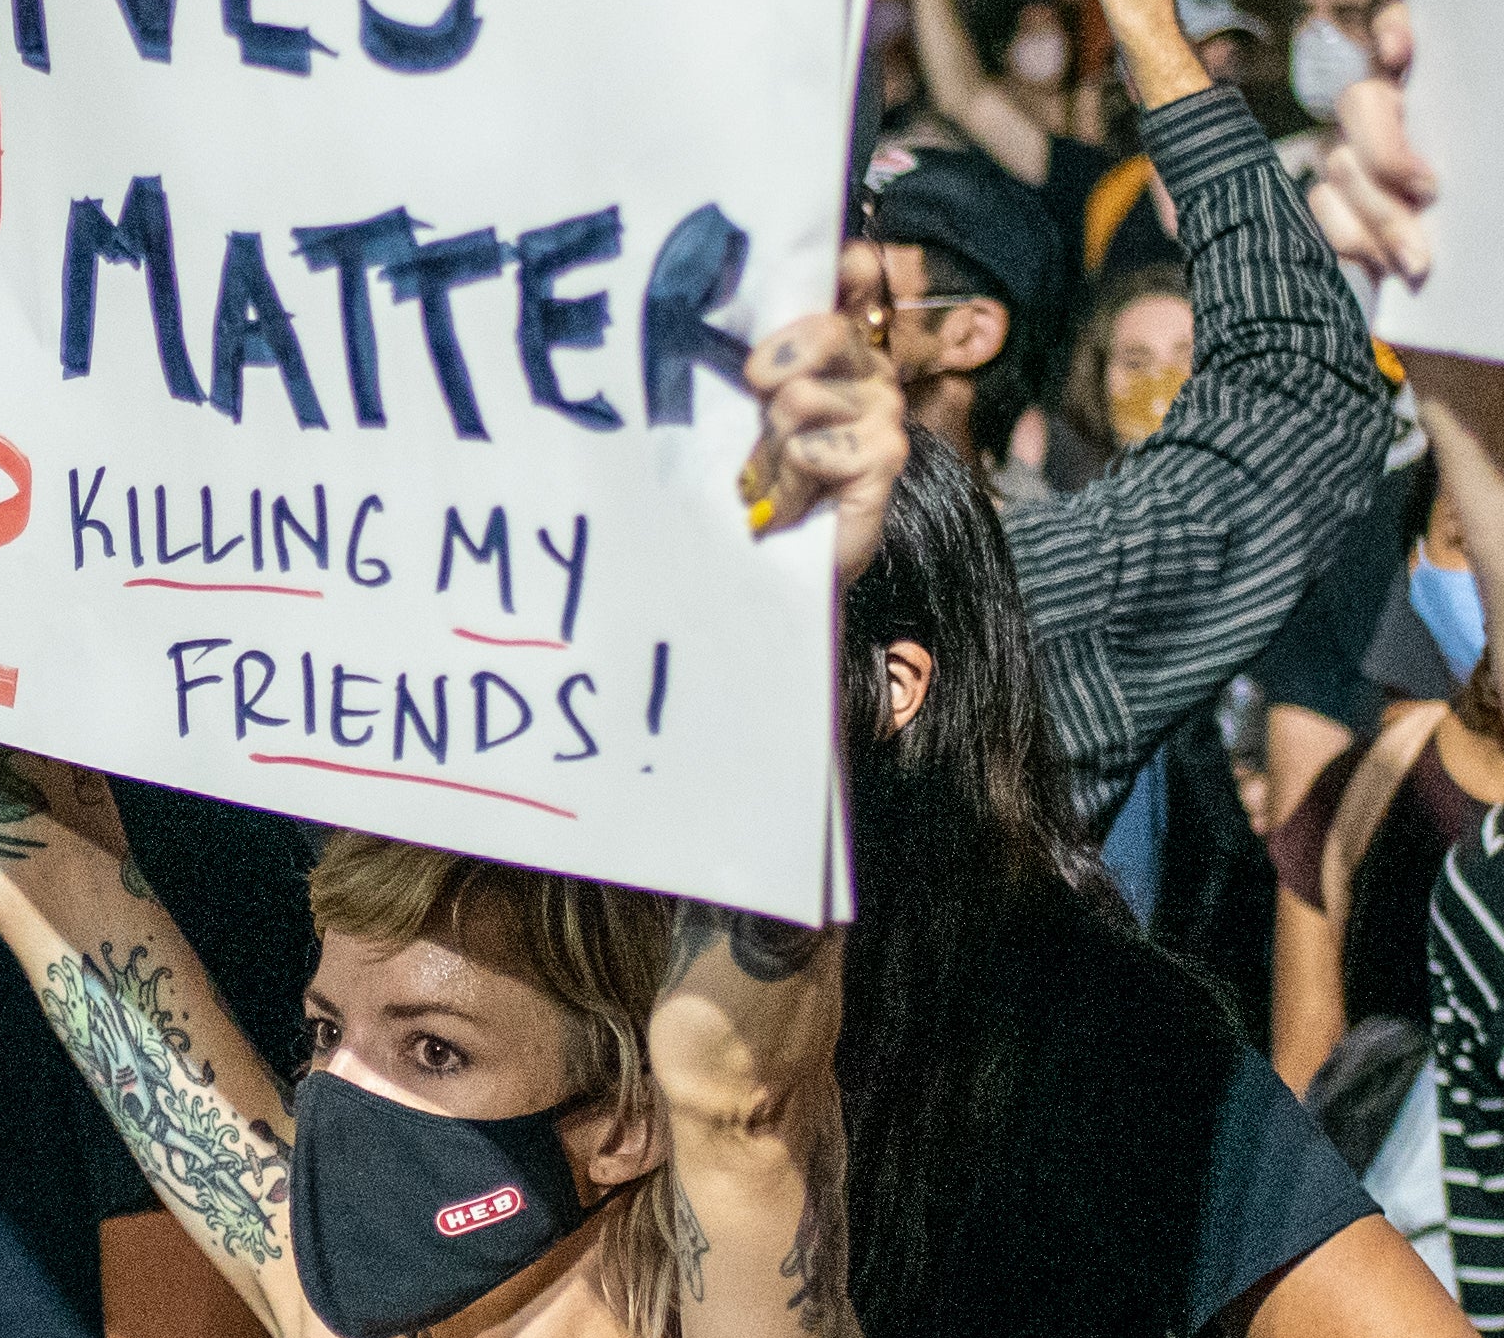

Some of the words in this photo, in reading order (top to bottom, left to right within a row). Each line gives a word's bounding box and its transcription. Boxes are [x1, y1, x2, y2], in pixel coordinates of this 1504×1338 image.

[59, 174, 756, 444] MATTER
[67, 464, 394, 589] KILLING
[434, 504, 589, 644] MY
